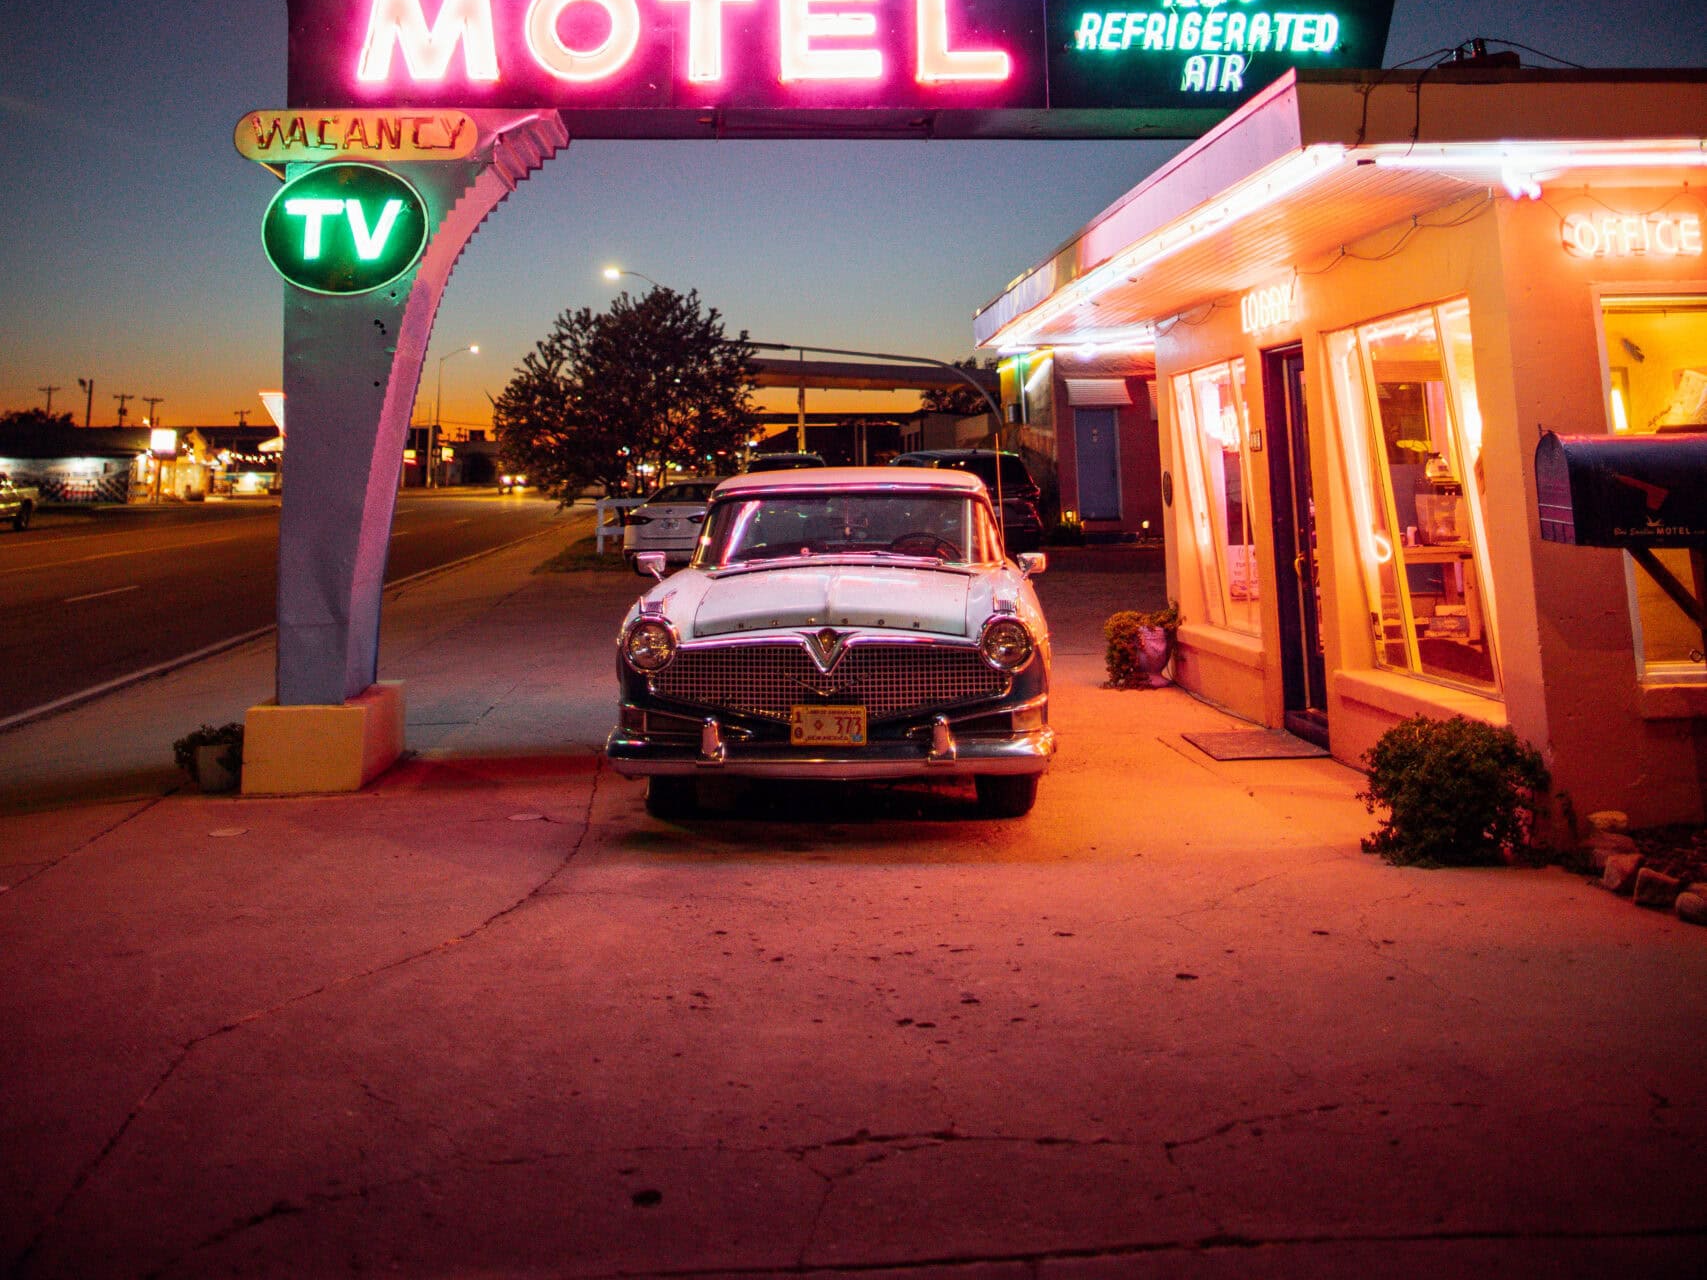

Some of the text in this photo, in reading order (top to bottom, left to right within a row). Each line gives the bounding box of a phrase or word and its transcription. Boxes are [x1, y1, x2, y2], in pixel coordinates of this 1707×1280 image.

[1075, 12, 1339, 52] REFRIGERATED
[1180, 54, 1247, 92] AIR
[252, 116, 467, 150] VACANCY
[284, 198, 404, 261] TV
[1567, 214, 1704, 257] OFFICE
[1241, 283, 1294, 334] LOBBY
[1656, 527, 1691, 535] MOTEL
[833, 716, 863, 735] 373
